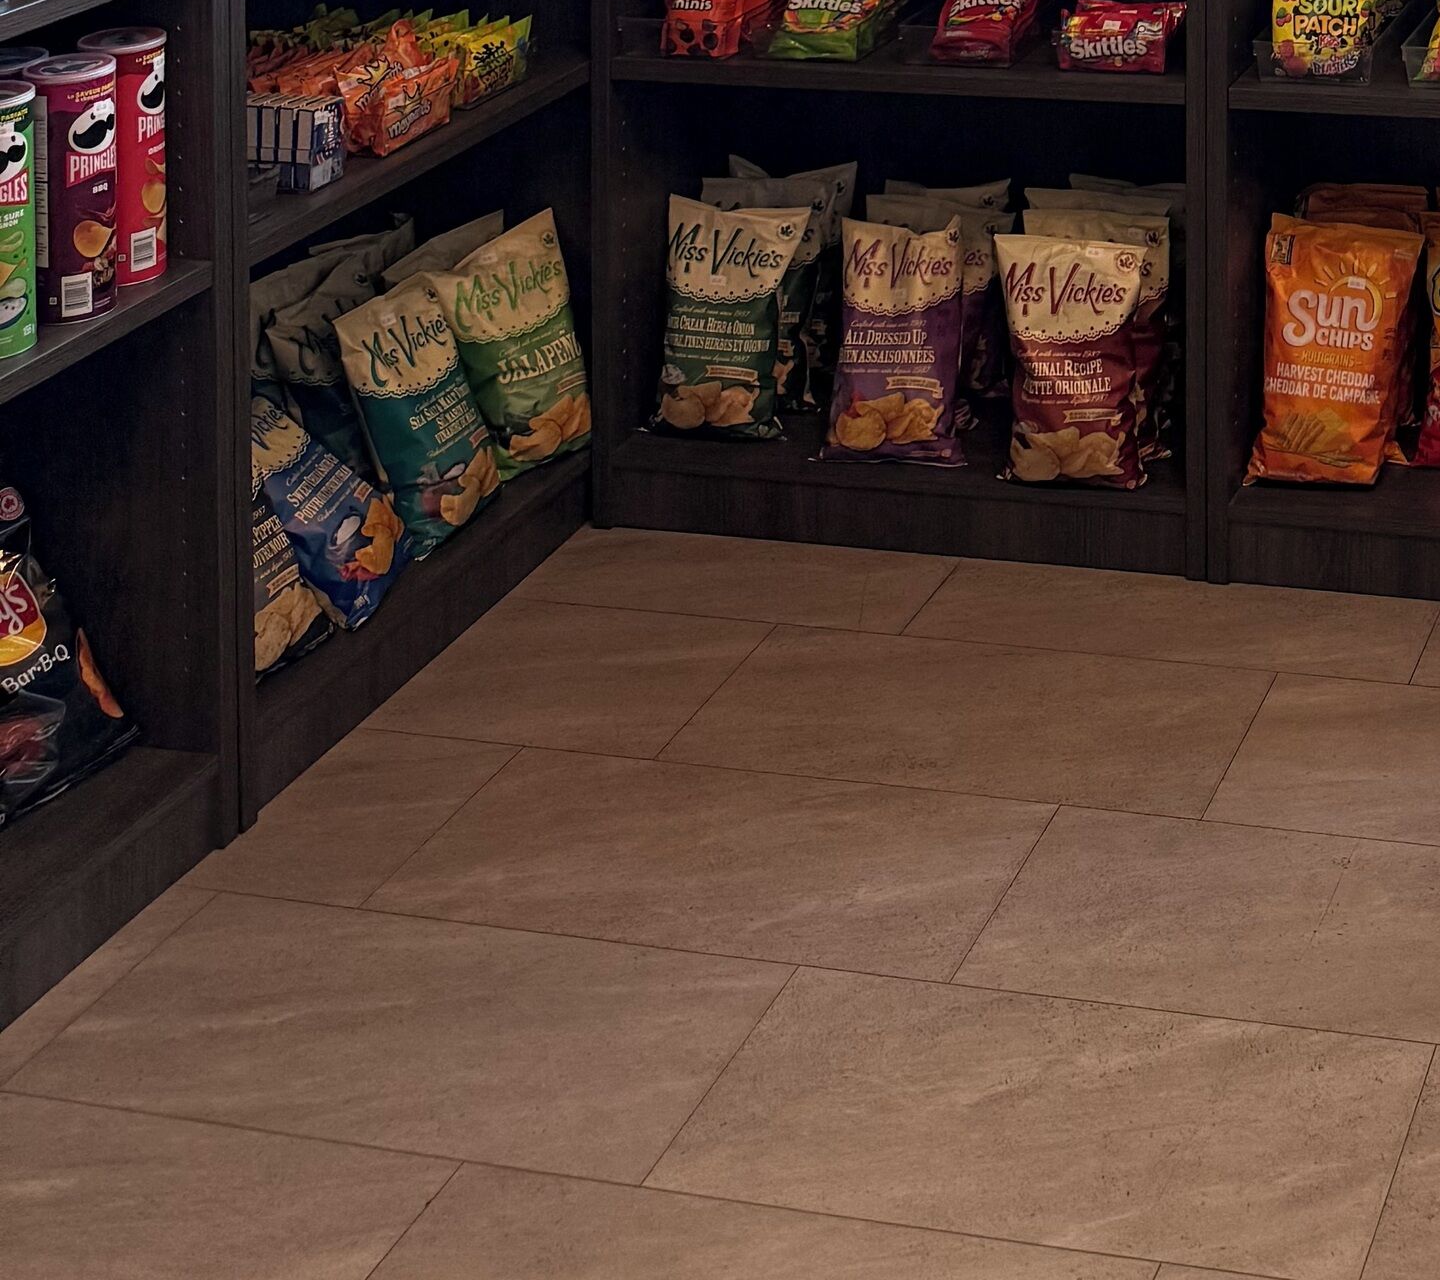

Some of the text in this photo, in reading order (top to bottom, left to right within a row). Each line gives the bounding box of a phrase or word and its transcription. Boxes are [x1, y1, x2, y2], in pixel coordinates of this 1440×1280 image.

[1293, 15, 1359, 38] PATCH
[1069, 35, 1148, 61] Skittles
[667, 222, 784, 279] Miss Vickie's
[844, 237, 953, 290] Miss Vickie's
[491, 260, 562, 311] Vickie's
[1005, 261, 1127, 318] Miss Vickie's
[1281, 289, 1383, 348] Sun
[844, 328, 928, 346] ALL DRESSED UP
[1315, 327, 1374, 352] CHIPS
[858, 347, 936, 364] ASSAISONNÉES
[1063, 357, 1104, 377] RECIPE
[1054, 376, 1112, 396] ORIGINALE
[1276, 361, 1376, 389] HARVEST CHEDDAR
[1264, 376, 1382, 405] CHEDDAR DE CAMPAGNE
